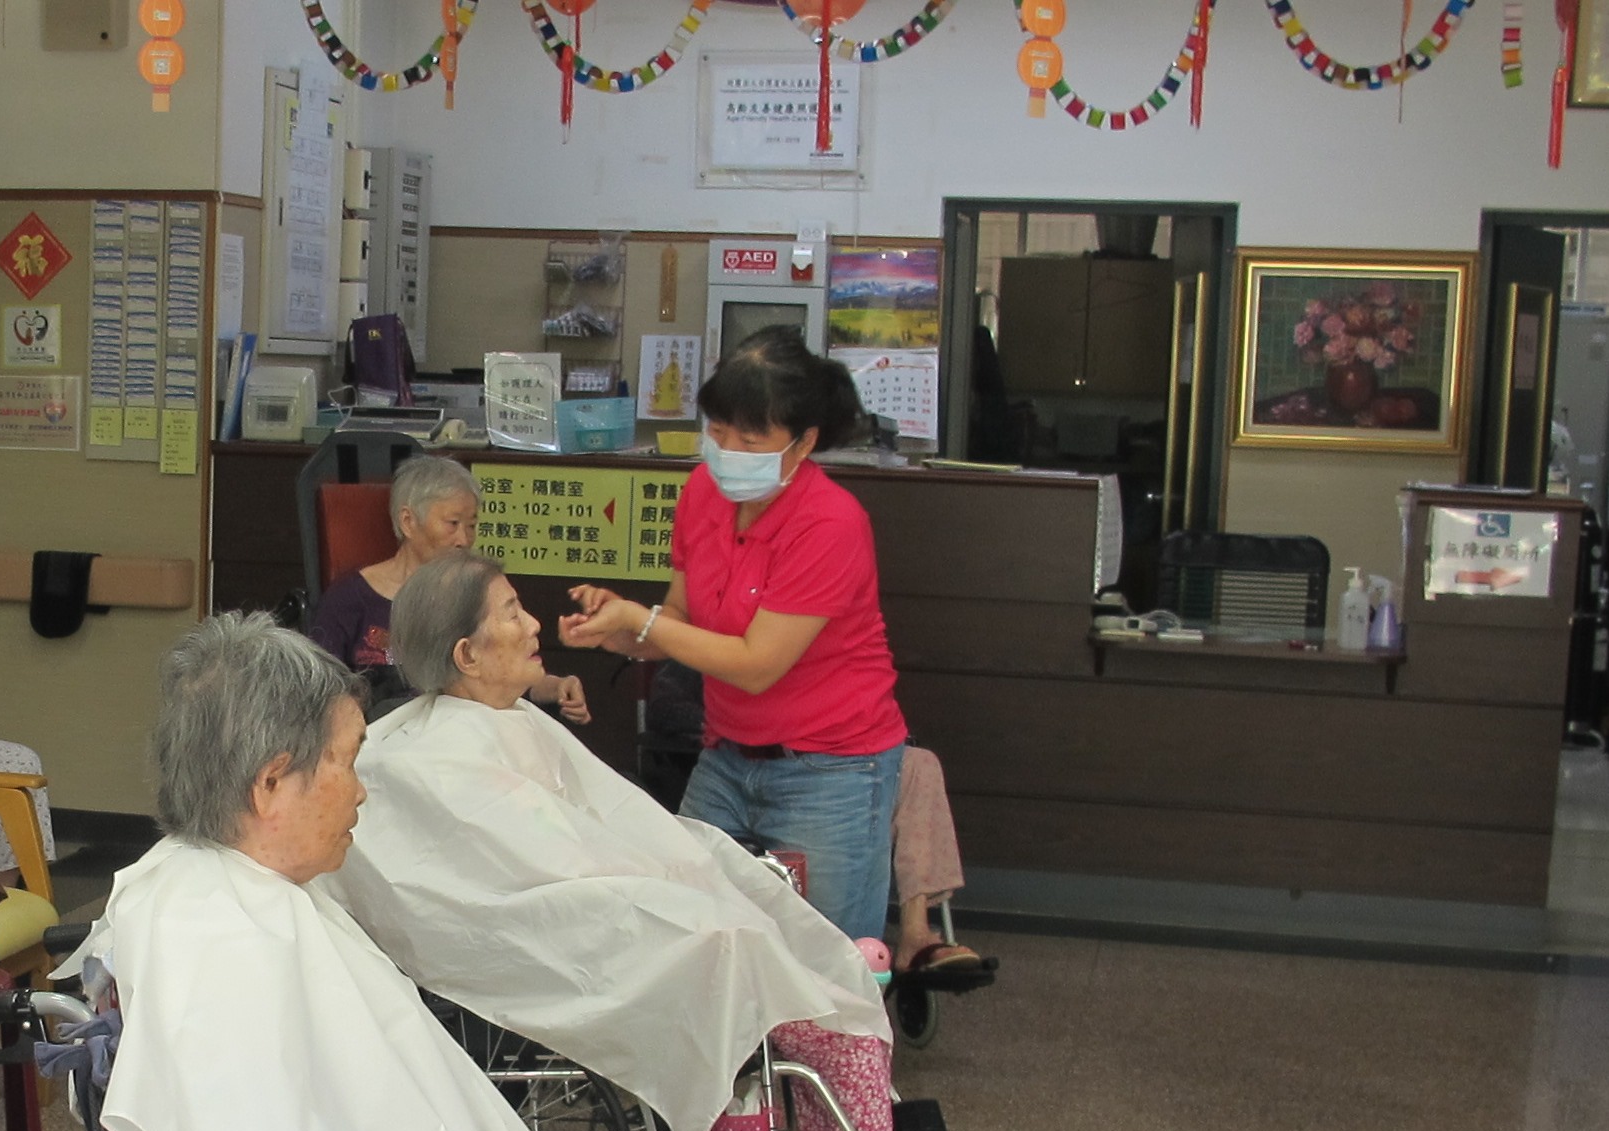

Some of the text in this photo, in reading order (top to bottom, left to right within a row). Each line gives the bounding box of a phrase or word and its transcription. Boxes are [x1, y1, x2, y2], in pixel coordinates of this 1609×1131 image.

[727, 102, 842, 114] 高齡友善健康照護構
[12, 234, 50, 278] 福
[742, 252, 774, 262] AED
[643, 482, 685, 500] 會議
[641, 506, 675, 523] 廚房
[640, 529, 673, 546] 廁所
